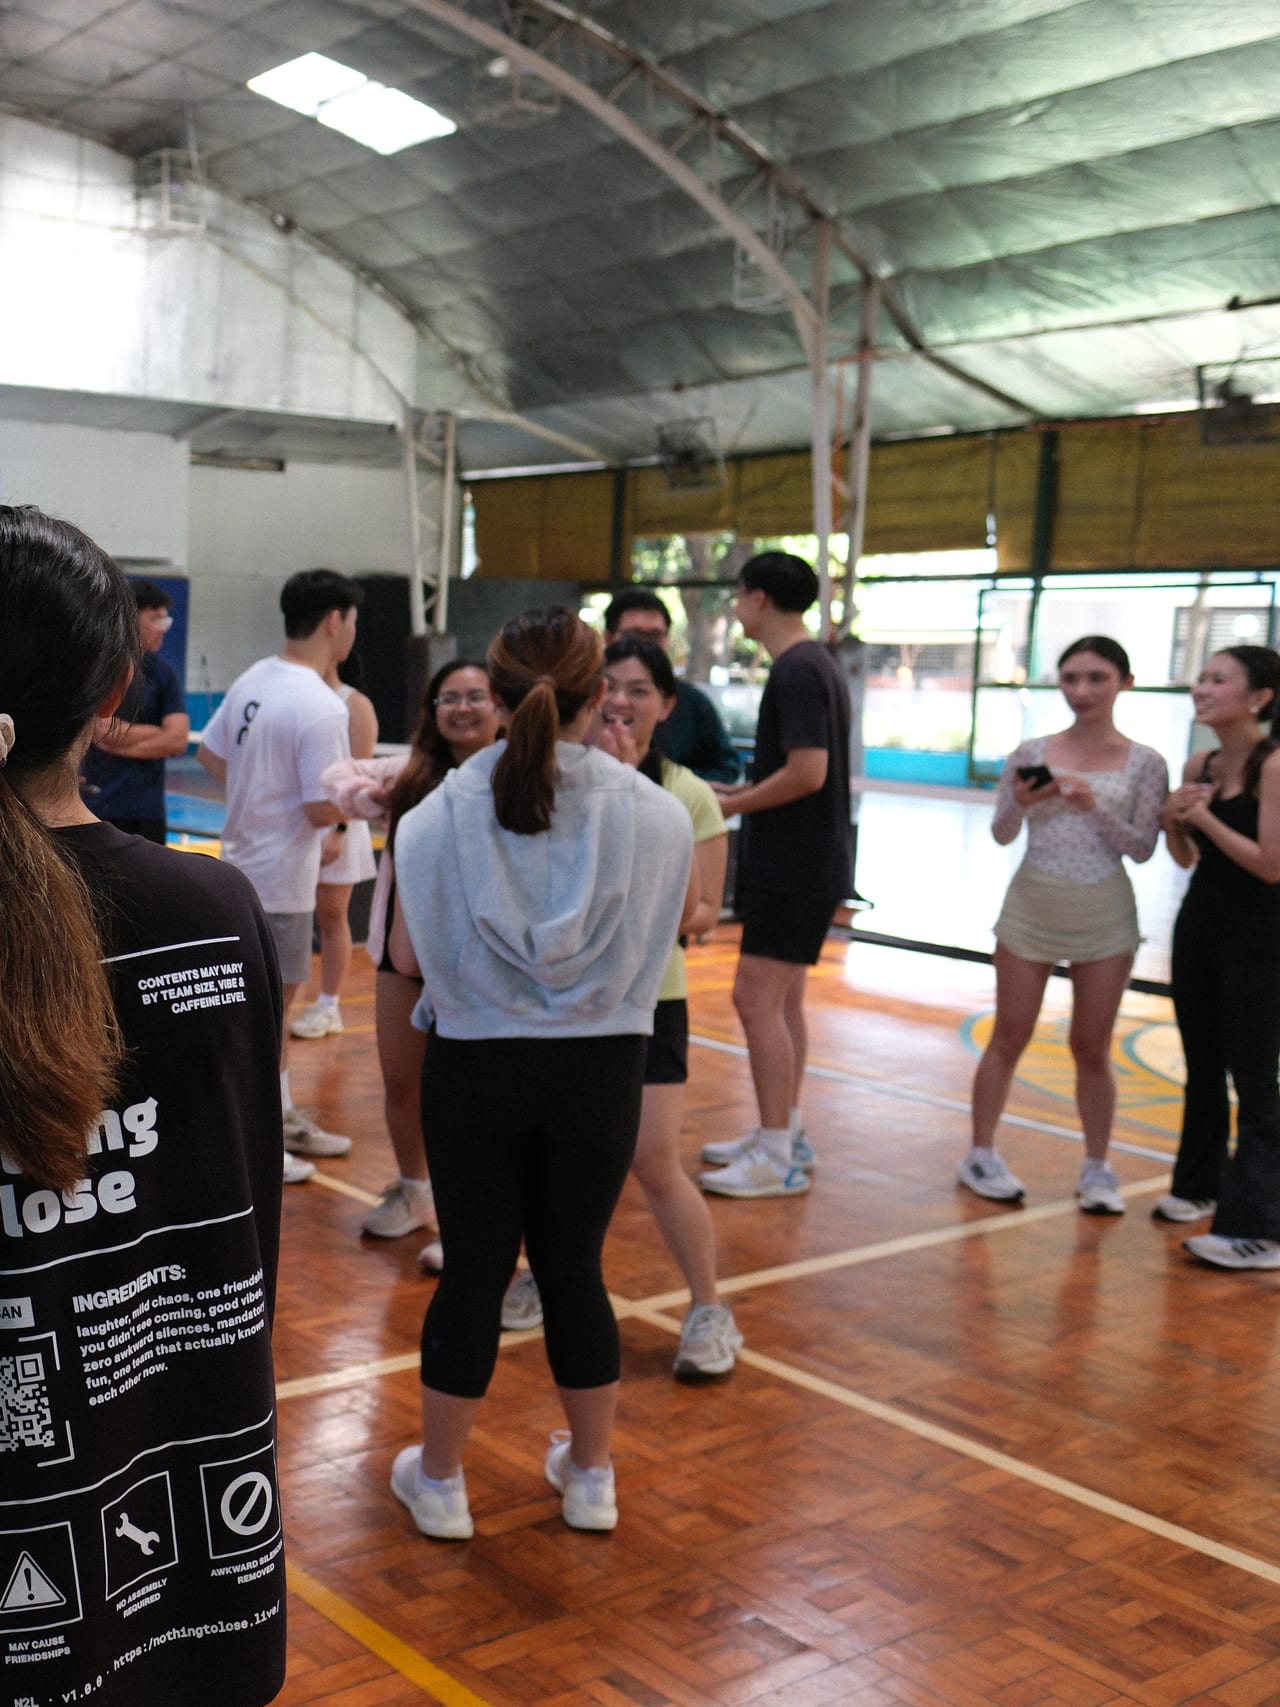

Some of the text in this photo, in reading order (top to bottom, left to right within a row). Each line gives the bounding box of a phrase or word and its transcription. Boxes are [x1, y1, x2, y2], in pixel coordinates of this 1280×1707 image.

[138, 962, 243, 990] CONTENTS MAY VARY
[142, 977, 245, 1005] BY TEAM SIZE, VIBE &
[171, 991, 246, 1014] CAFFEINE LEVEL
[0, 1170, 137, 1238] lose
[72, 1264, 187, 1313] INGREDIENTS:
[76, 1315, 131, 1338] laughter,
[132, 1300, 150, 1320] mild
[151, 1291, 194, 1309] chaos,
[196, 1287, 221, 1301] one
[80, 1341, 105, 1357] you
[107, 1325, 136, 1348] didn't
[136, 1318, 152, 1333] see
[154, 1306, 206, 1325] coming,
[208, 1297, 239, 1317] good
[83, 1357, 112, 1373] zero
[114, 1331, 154, 1363] awkward
[155, 1321, 214, 1341] silences,
[86, 1375, 111, 1389] fun,
[113, 1364, 131, 1380] one
[132, 1349, 154, 1369] team
[155, 1341, 182, 1356] that
[184, 1332, 236, 1351] actually
[88, 1361, 169, 1406] each other now.
[210, 1560, 259, 1577] AWKWARD
[237, 1562, 275, 1584] REMOVED
[116, 1577, 168, 1612] NO ASSEMBLY
[123, 1592, 161, 1619] REQUIRED
[5, 1646, 71, 1664] FRIENDSHIPS
[8, 1635, 65, 1651] MAY CAUSE
[61, 1674, 102, 1703] v1.0.0
